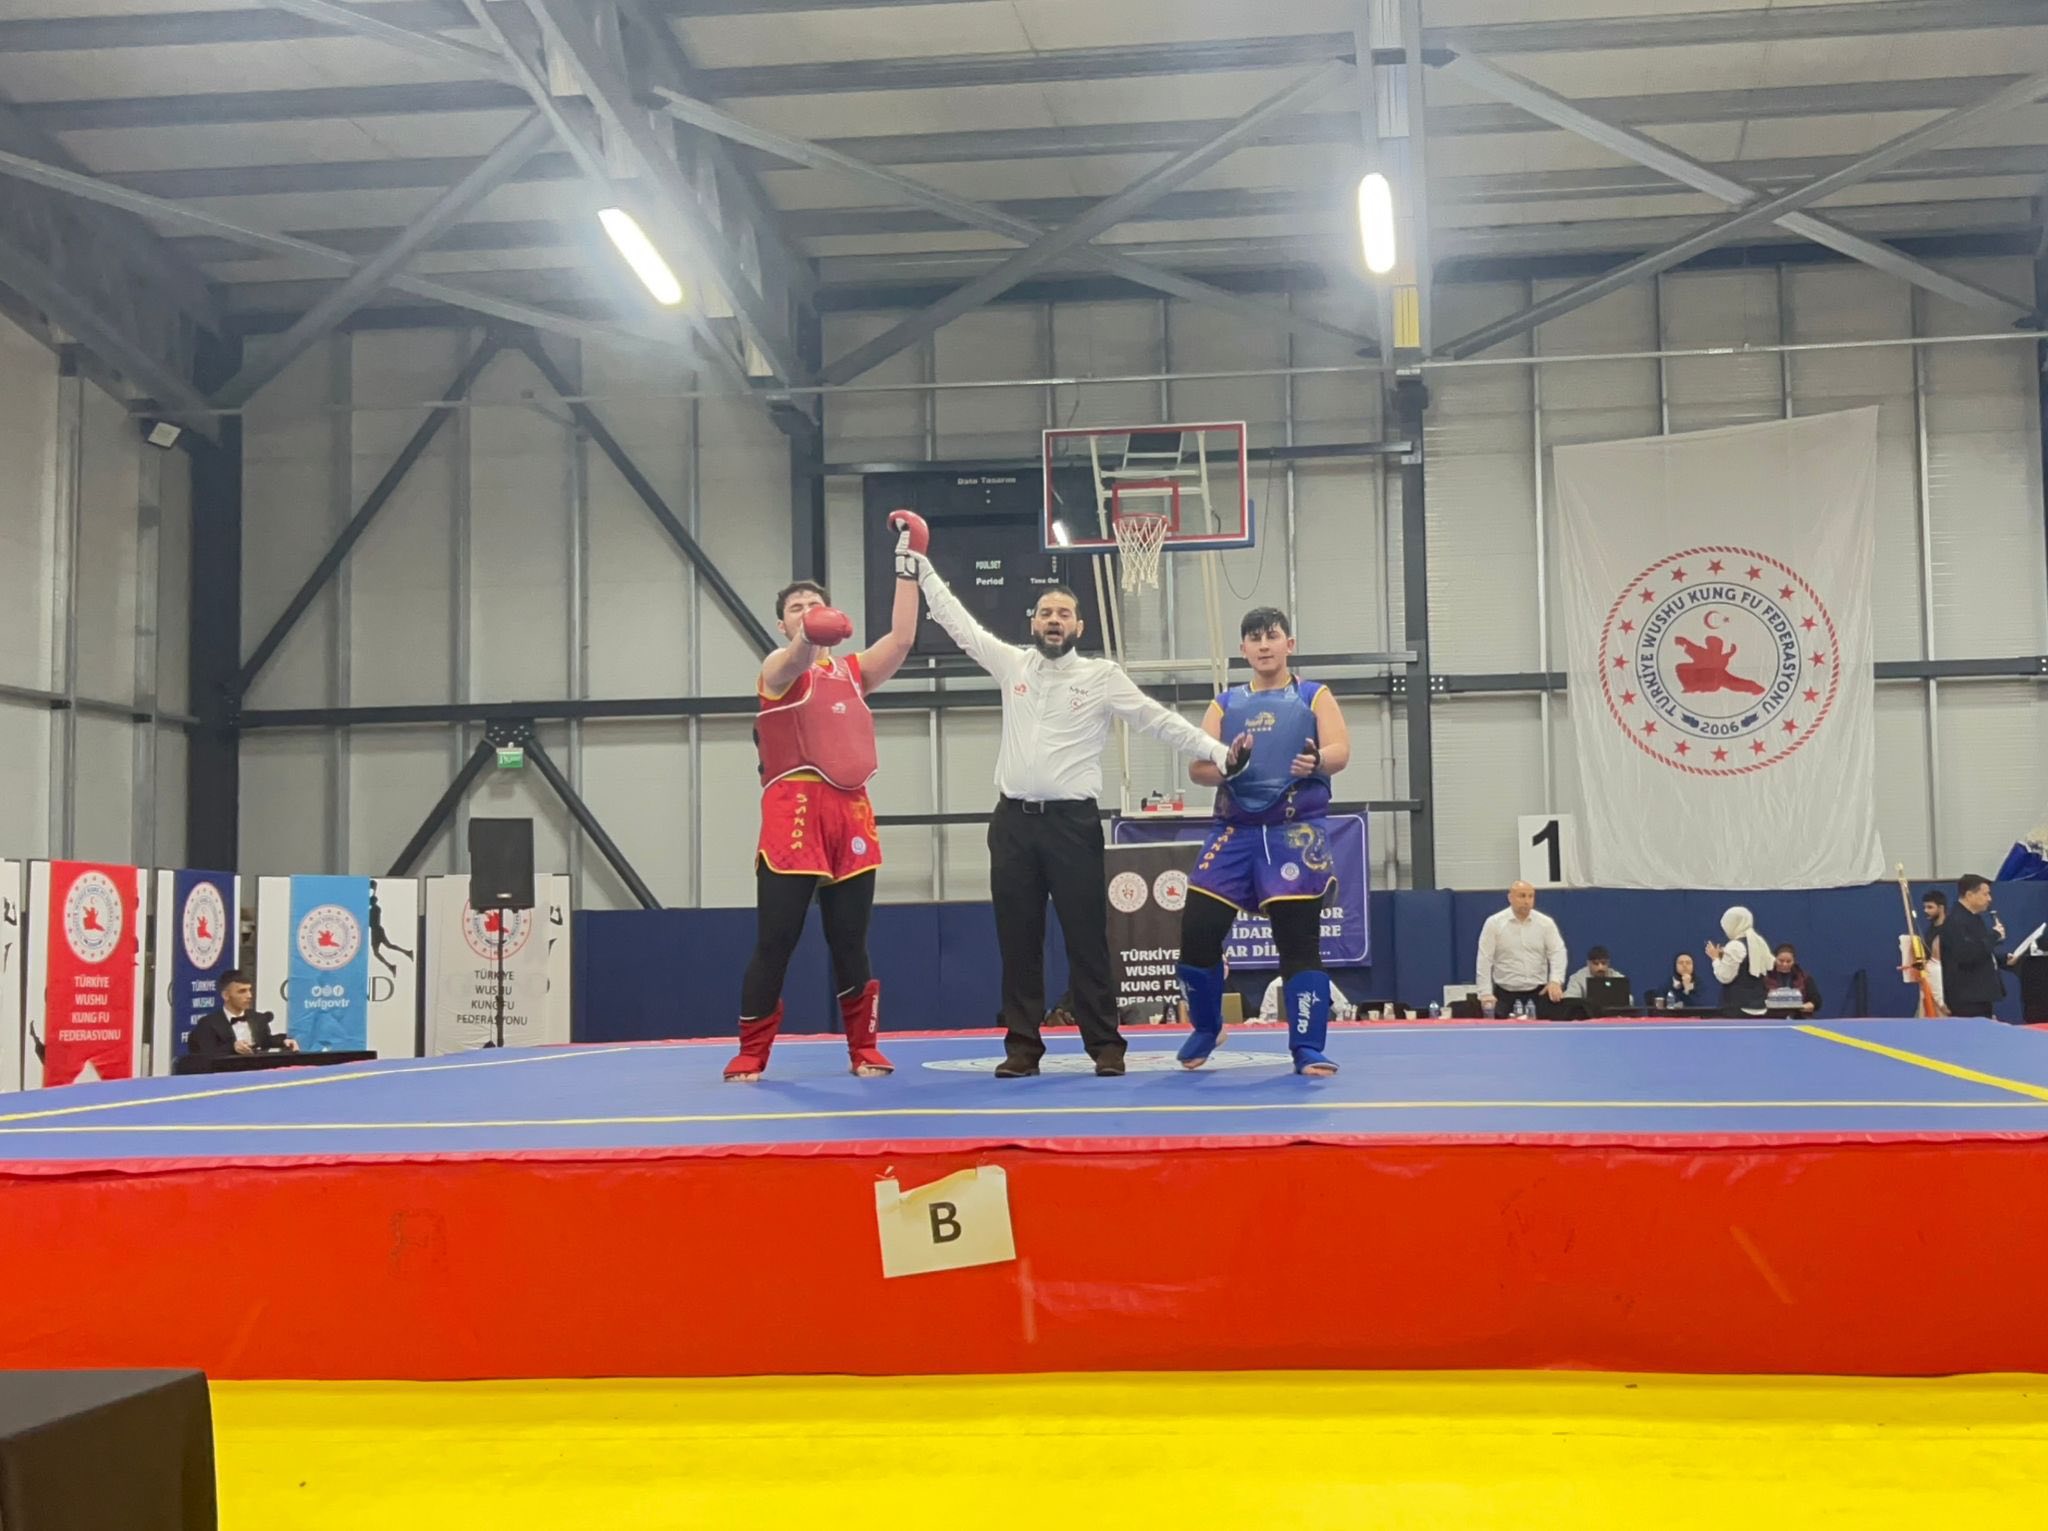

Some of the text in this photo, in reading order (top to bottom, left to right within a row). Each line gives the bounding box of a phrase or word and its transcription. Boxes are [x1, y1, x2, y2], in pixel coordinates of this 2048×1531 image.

[975, 577, 1004, 586] Period
[1639, 586, 1797, 717] TÜRKİYE WUSHU KUNG FU FEDERASYONU
[1699, 721, 1740, 736] 2006
[1532, 820, 1562, 882] 1
[1120, 947, 1181, 962] TÜRKİYE
[474, 968, 515, 980] TÜRKYE
[1125, 964, 1176, 977] WUSHU
[74, 976, 110, 988] TÜRKİYE
[1120, 980, 1160, 992] KUNG
[475, 985, 512, 995] WUSU
[74, 994, 108, 1006] WUSHU
[71, 1012, 110, 1023] KUNG FU
[59, 1029, 121, 1041] FEDERASYONU
[929, 1201, 962, 1244] B
